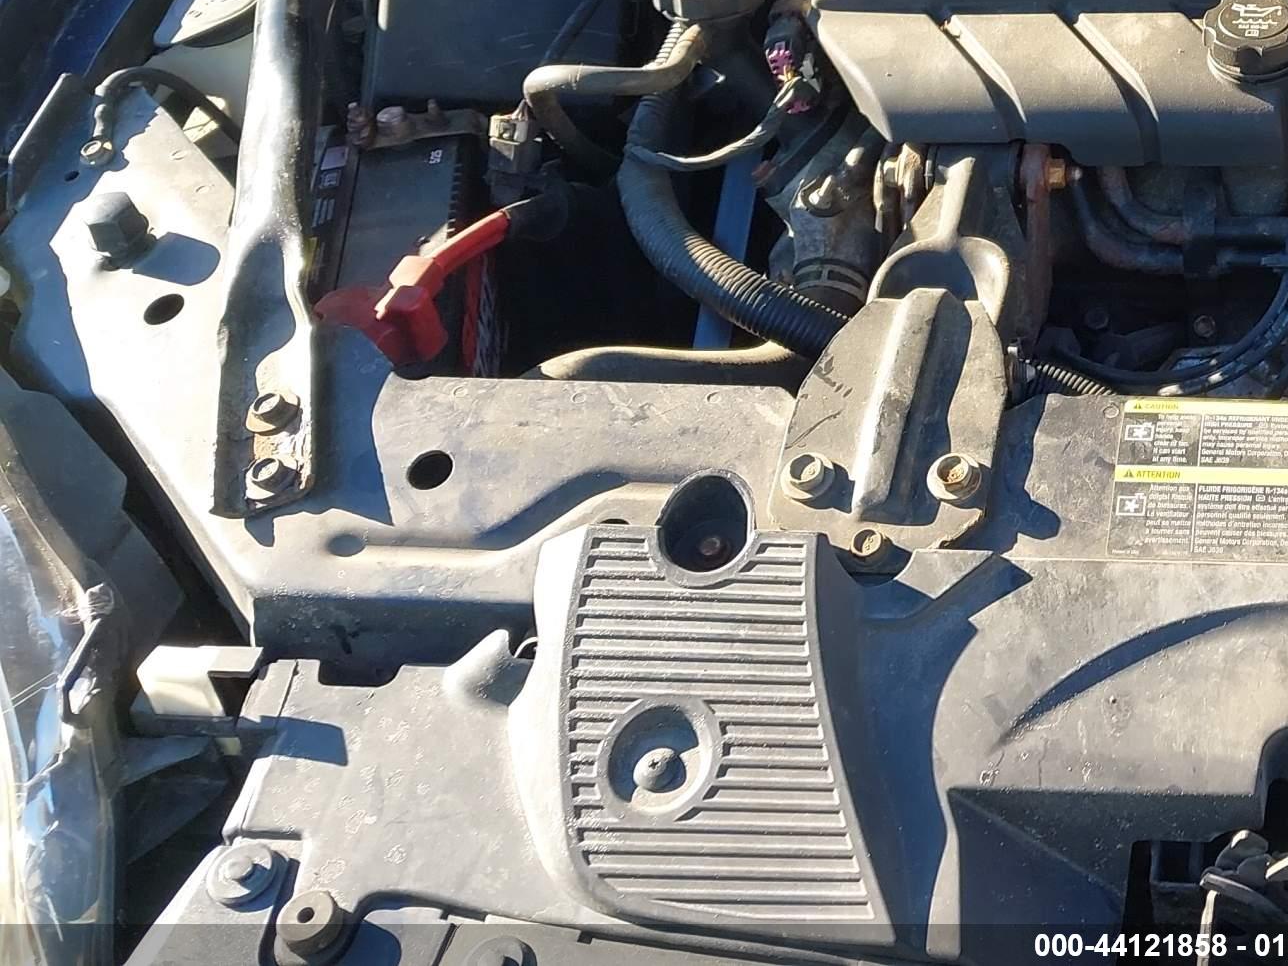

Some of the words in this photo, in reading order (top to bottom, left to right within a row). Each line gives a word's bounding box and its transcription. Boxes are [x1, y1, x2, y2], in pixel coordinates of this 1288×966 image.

[1136, 470, 1180, 478] ATTENTION
[1198, 484, 1221, 492] FLUIDE
[1265, 486, 1288, 494] R-134a
[1198, 493, 1219, 501] HAUTE
[1220, 494, 1252, 502] PRESSION
[1197, 502, 1224, 510] système
[1277, 504, 1288, 512] par
[1194, 536, 1218, 544] General
[1219, 537, 1240, 545] Motors
